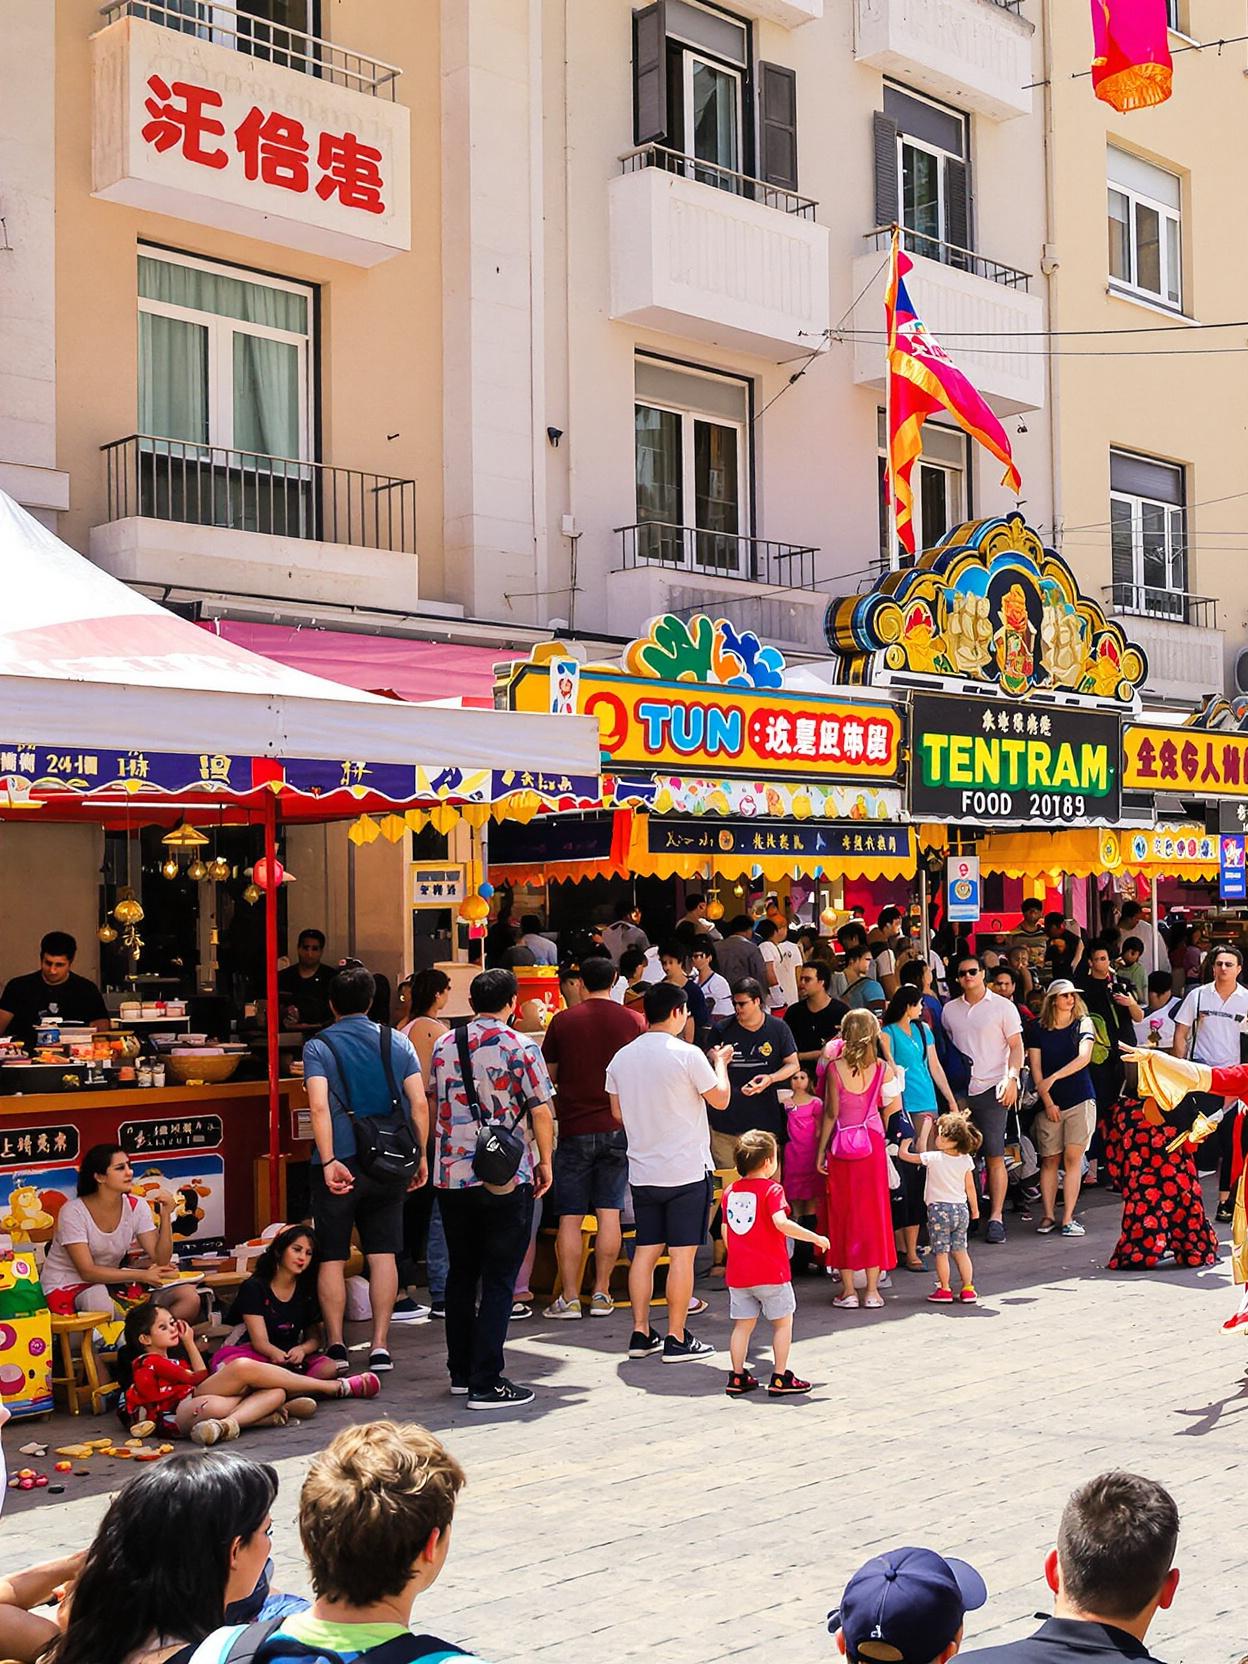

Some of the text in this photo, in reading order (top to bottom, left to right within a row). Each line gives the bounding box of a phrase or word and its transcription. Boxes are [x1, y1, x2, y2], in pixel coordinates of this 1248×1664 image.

[640, 704, 741, 752] TUN
[923, 733, 1107, 790] TENTRAM
[962, 790, 1012, 816] FOOD
